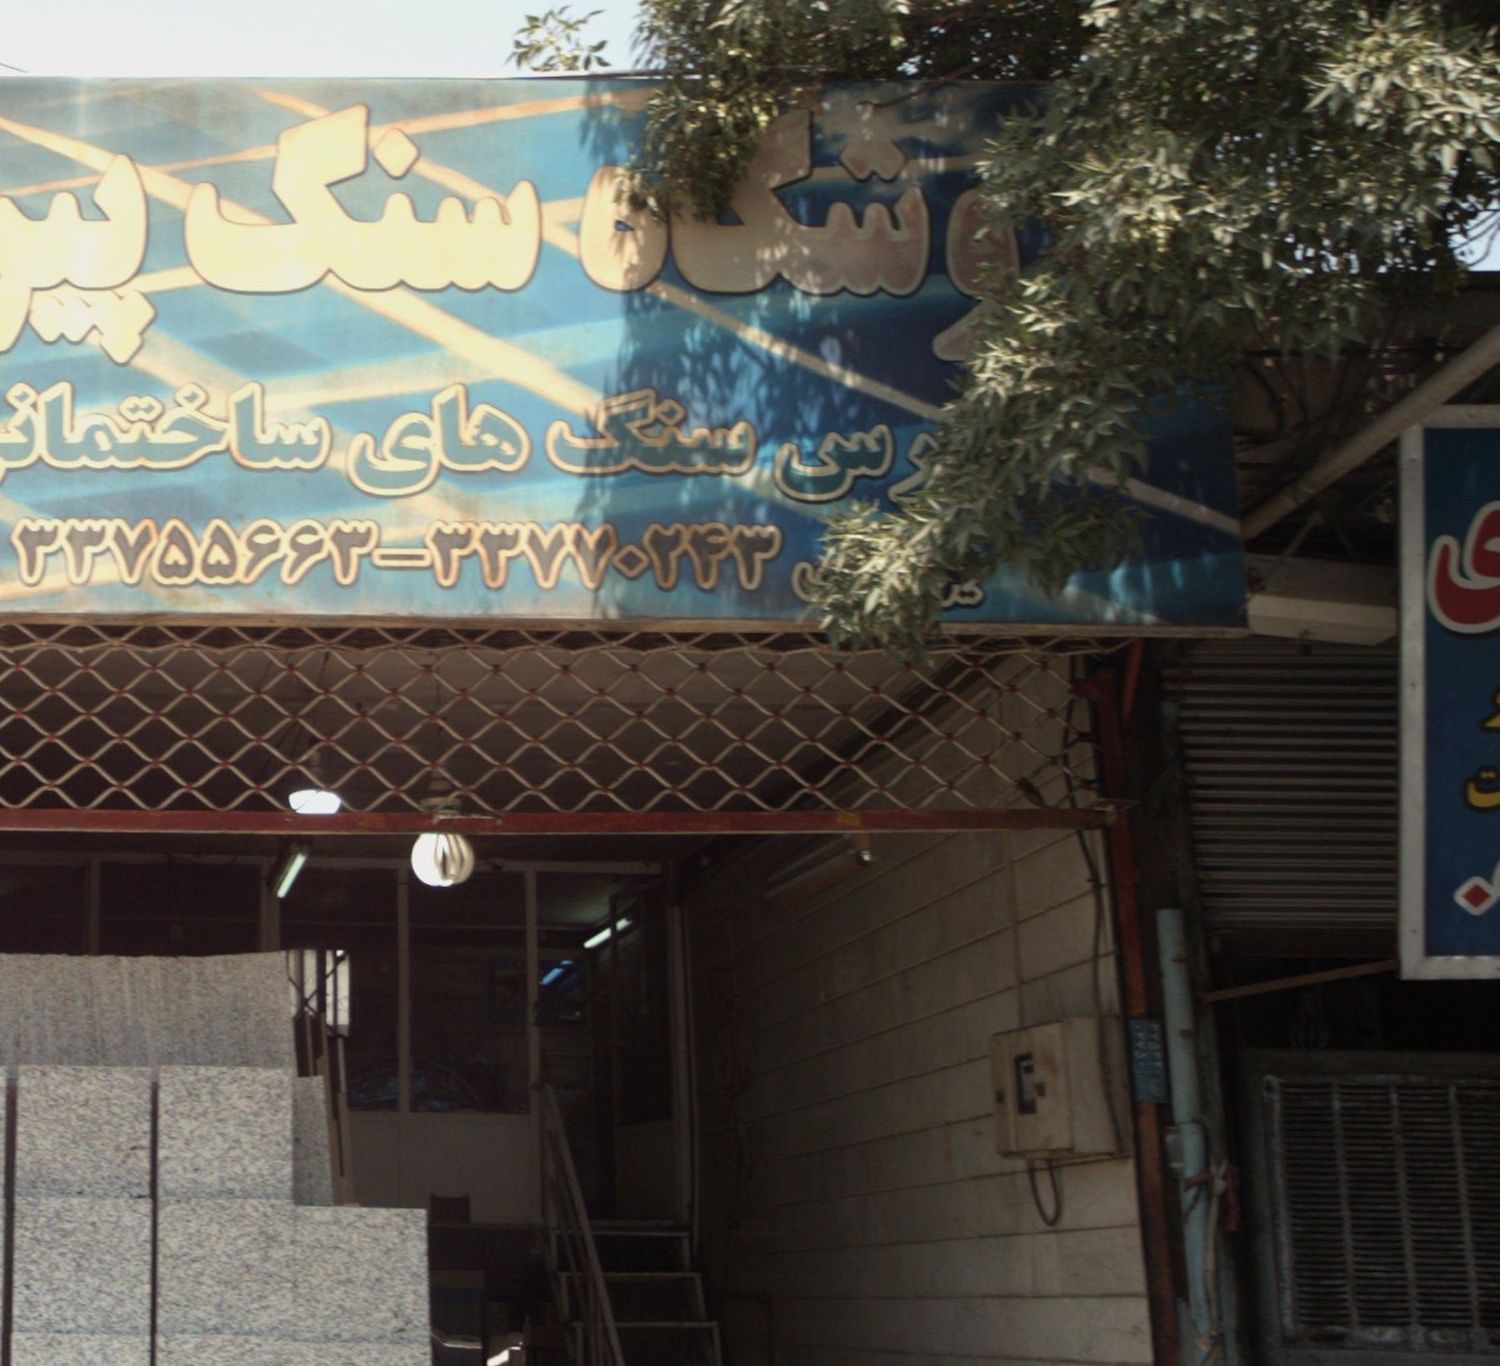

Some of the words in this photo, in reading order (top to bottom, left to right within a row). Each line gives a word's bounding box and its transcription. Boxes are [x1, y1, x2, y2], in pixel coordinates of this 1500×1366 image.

[183, 102, 542, 295] سنگ
[345, 382, 532, 497] های
[545, 387, 757, 478] سنگ
